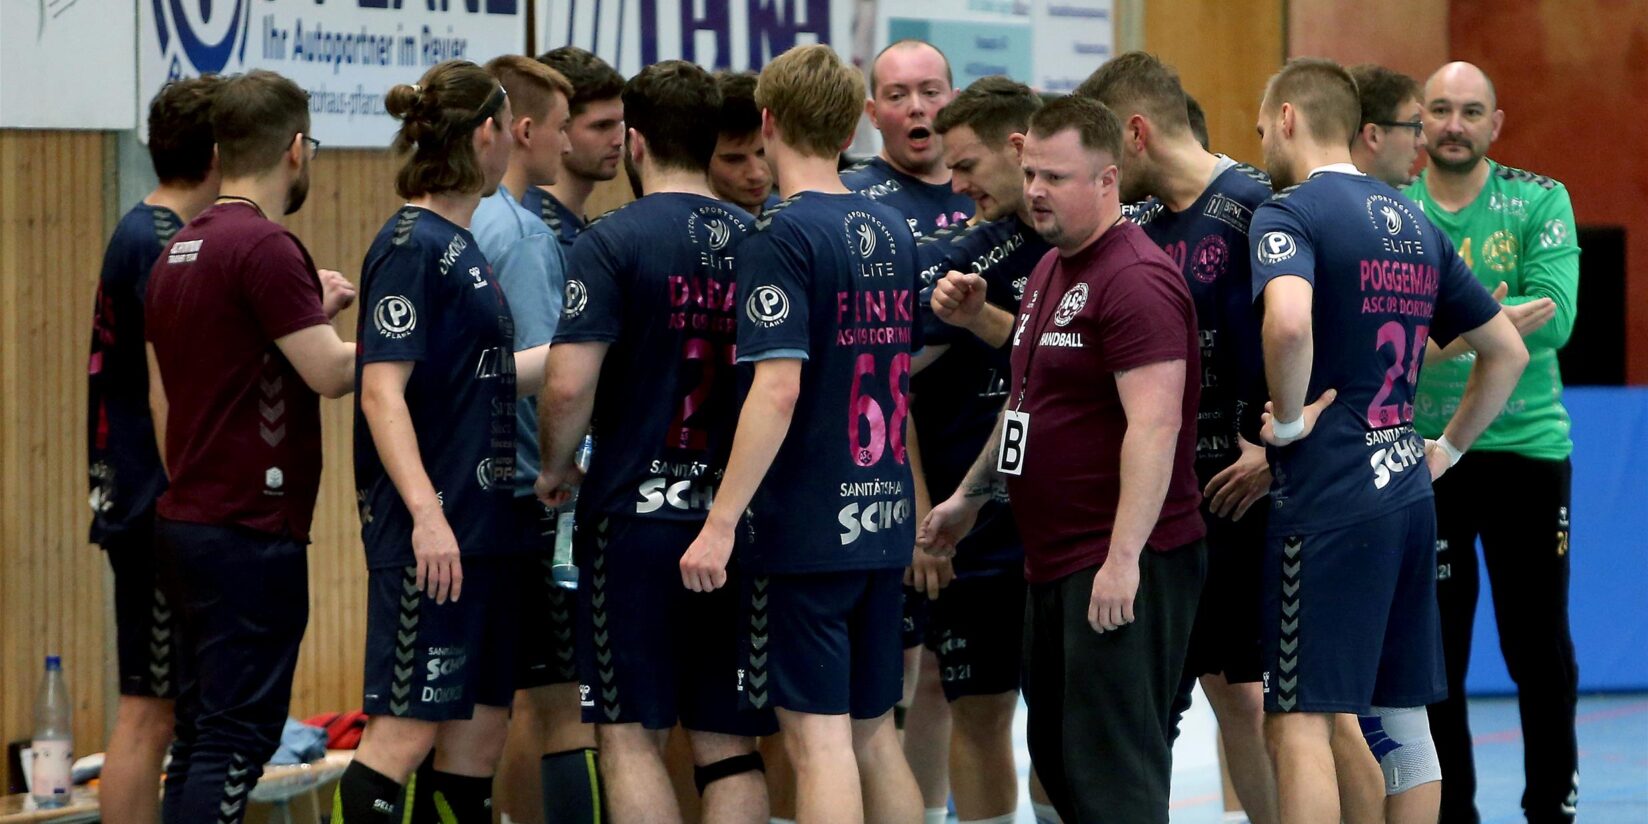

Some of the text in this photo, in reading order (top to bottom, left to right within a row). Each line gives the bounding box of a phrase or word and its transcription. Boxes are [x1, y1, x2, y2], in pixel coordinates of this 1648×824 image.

[263, 13, 287, 60] Ihr
[292, 18, 393, 74] Autopartner
[397, 22, 415, 66] im
[700, 252, 735, 270] ELIT
[387, 299, 408, 326] P
[759, 288, 779, 315] P
[1362, 296, 1385, 314] ASC
[848, 352, 912, 467] 68
[1001, 419, 1024, 471] B
[636, 477, 713, 514] SCH
[839, 477, 904, 498] SANITÄTSHA
